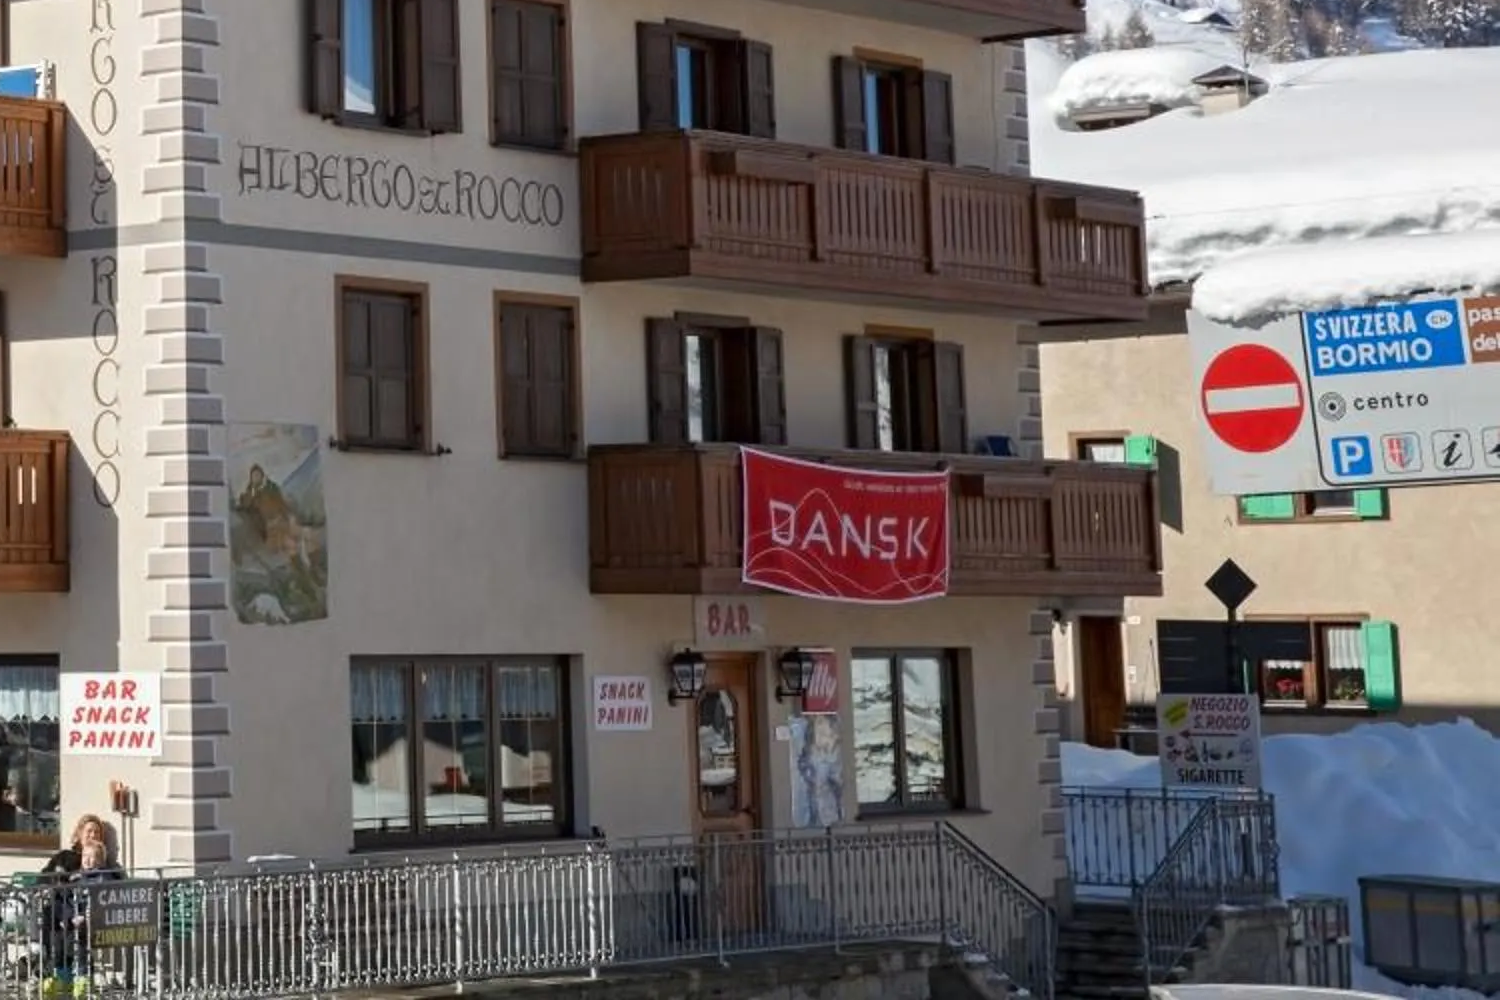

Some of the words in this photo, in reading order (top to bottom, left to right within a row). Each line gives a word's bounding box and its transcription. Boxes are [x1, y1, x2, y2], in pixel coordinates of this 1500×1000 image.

[237, 141, 415, 211] ALBERGO
[452, 168, 564, 227] ROCCO
[1314, 309, 1418, 341] SVIZZERA
[1316, 337, 1433, 369] BORMIO
[91, 255, 120, 508] ROCCO
[1353, 391, 1429, 411] centro
[1338, 440, 1364, 474] P
[769, 499, 930, 561] DANSK
[707, 602, 751, 637] BAR
[84, 679, 137, 700] BAR
[599, 681, 645, 701] SNACK
[1190, 696, 1249, 713] NEGOZIO
[72, 705, 151, 725] SNACK
[597, 706, 649, 725] PANINI
[69, 729, 156, 749] PANINI
[1177, 766, 1246, 785] SIGARETTE
[98, 887, 154, 905] CAMERE
[105, 907, 149, 925] LIBERE
